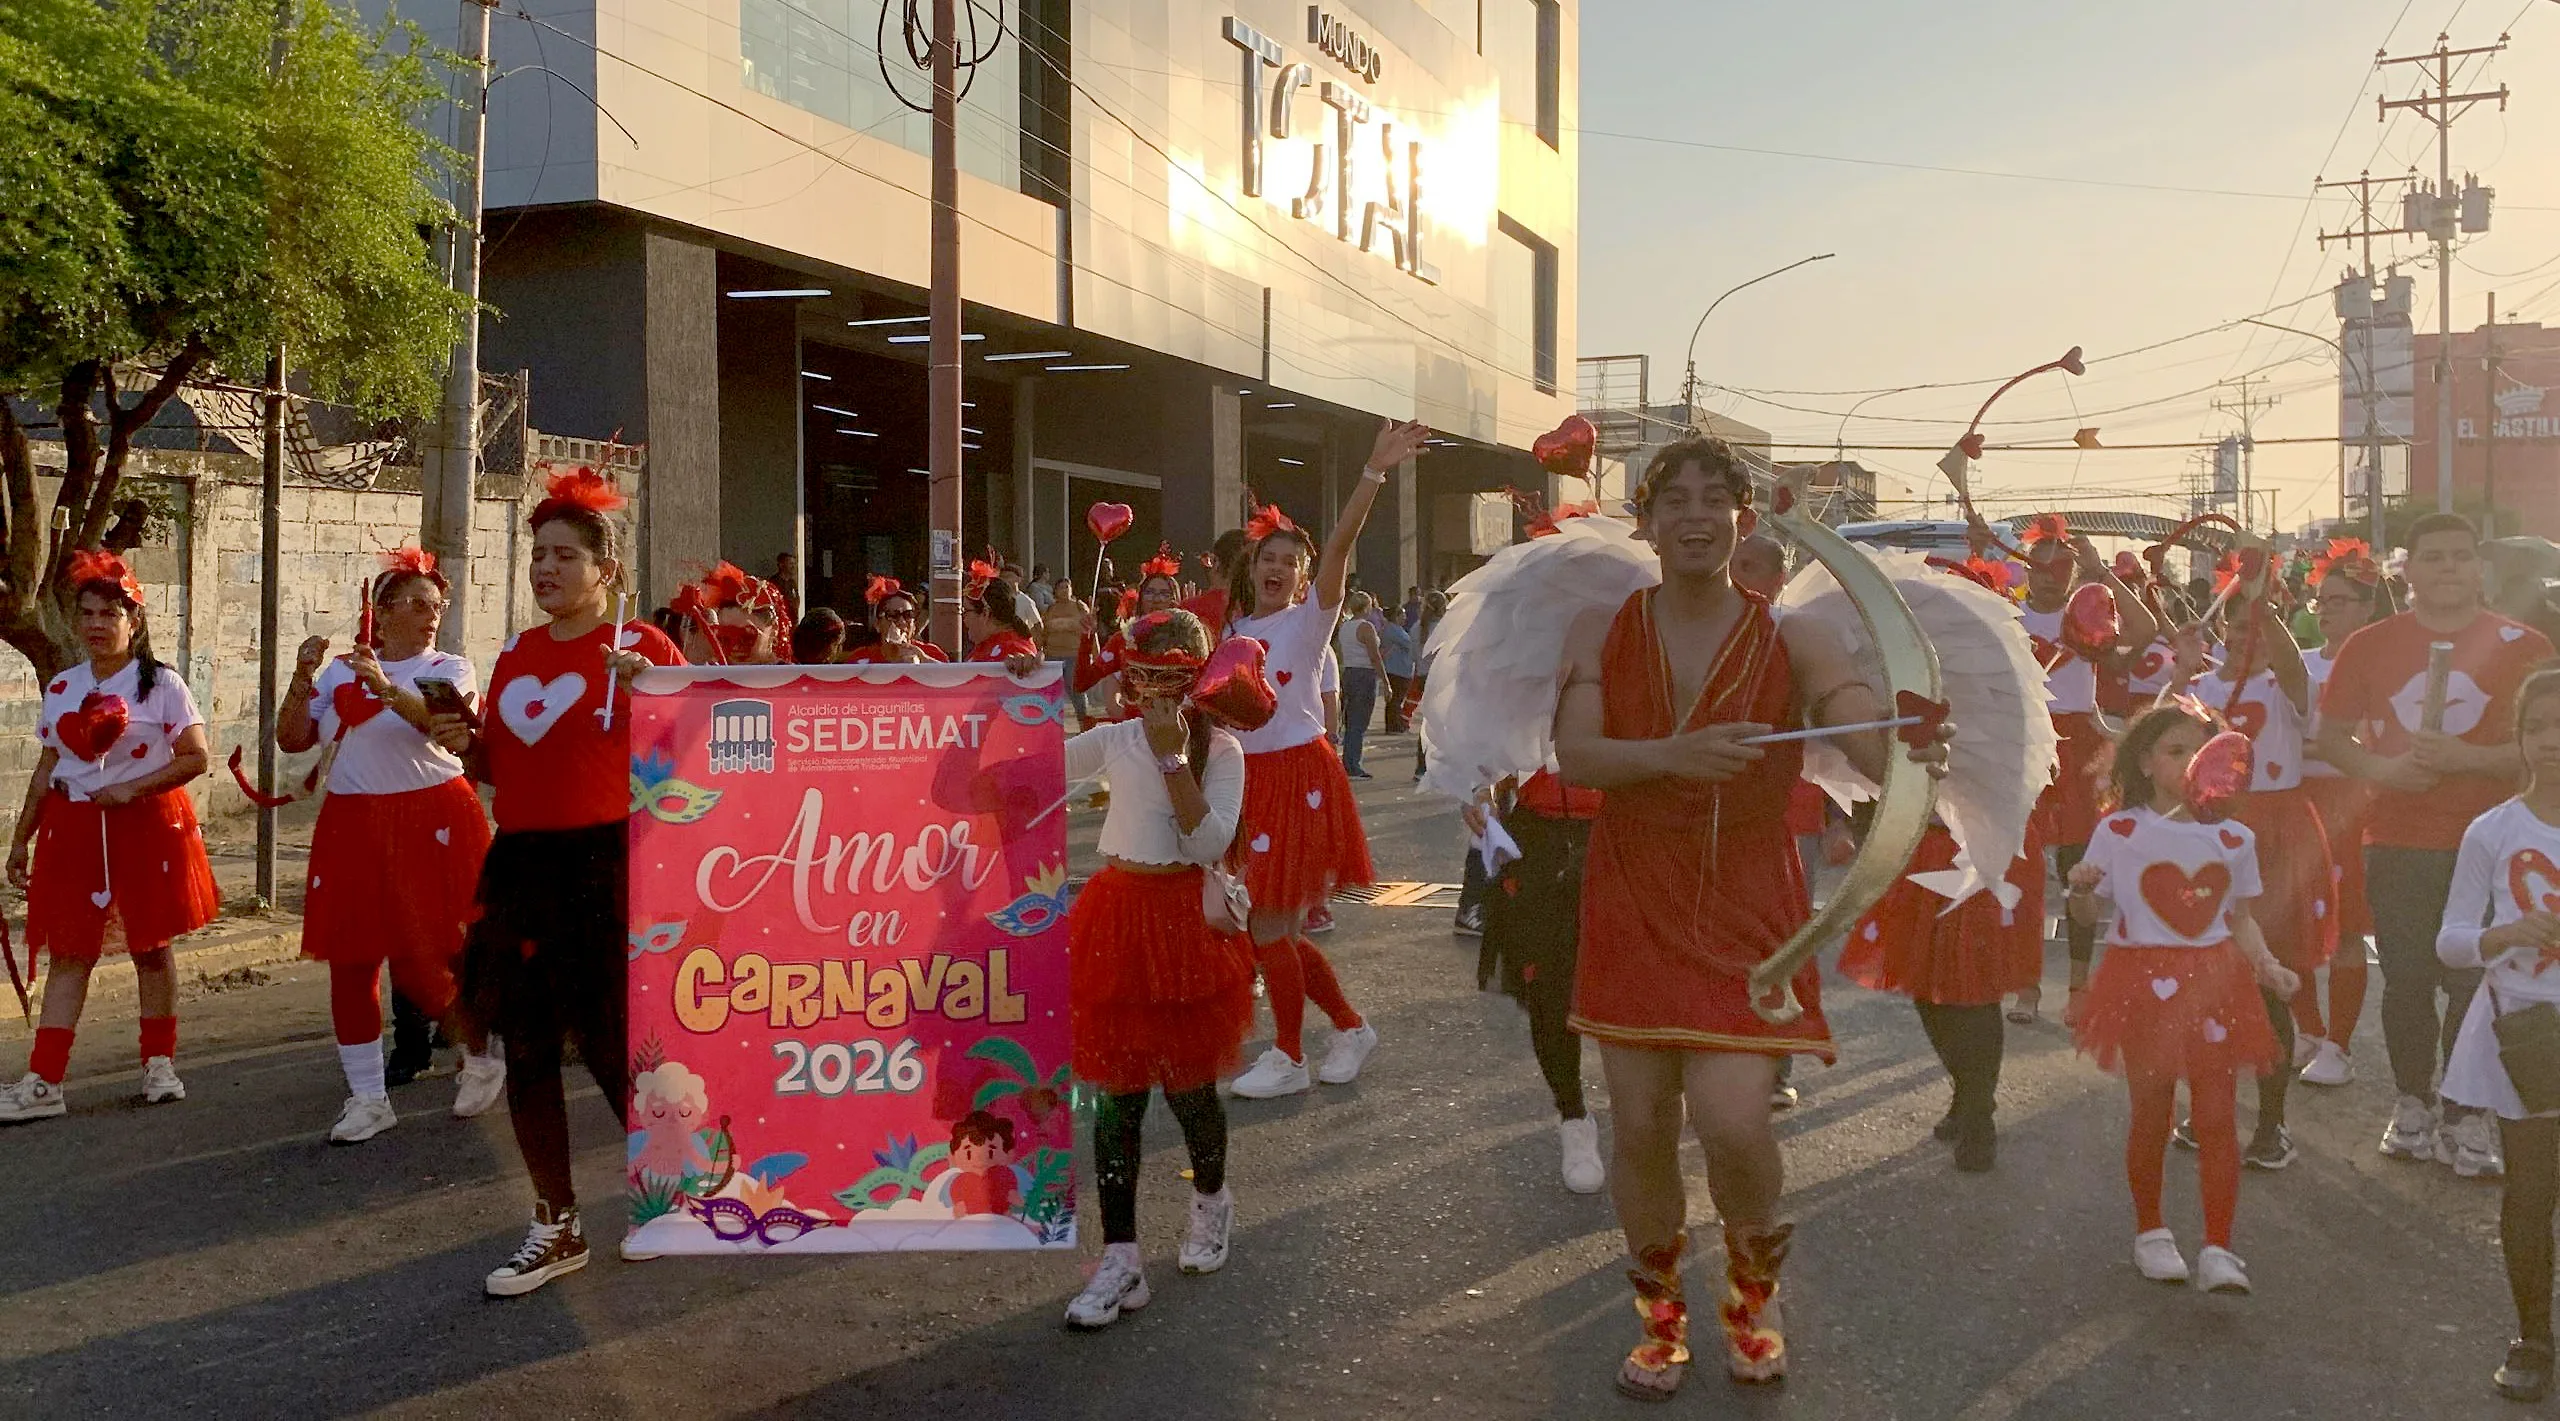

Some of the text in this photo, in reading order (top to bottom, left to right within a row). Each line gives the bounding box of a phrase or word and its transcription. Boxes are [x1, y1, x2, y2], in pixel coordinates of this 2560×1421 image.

[1308, 5, 1381, 84] MUNDO
[2457, 418, 2479, 438] EL
[841, 703, 858, 715] de
[861, 701, 925, 717] Lagunillas
[786, 714, 988, 753] SEDEMAT
[695, 787, 999, 933] Amor
[848, 908, 911, 948] en
[773, 1036, 925, 1096] 2026
